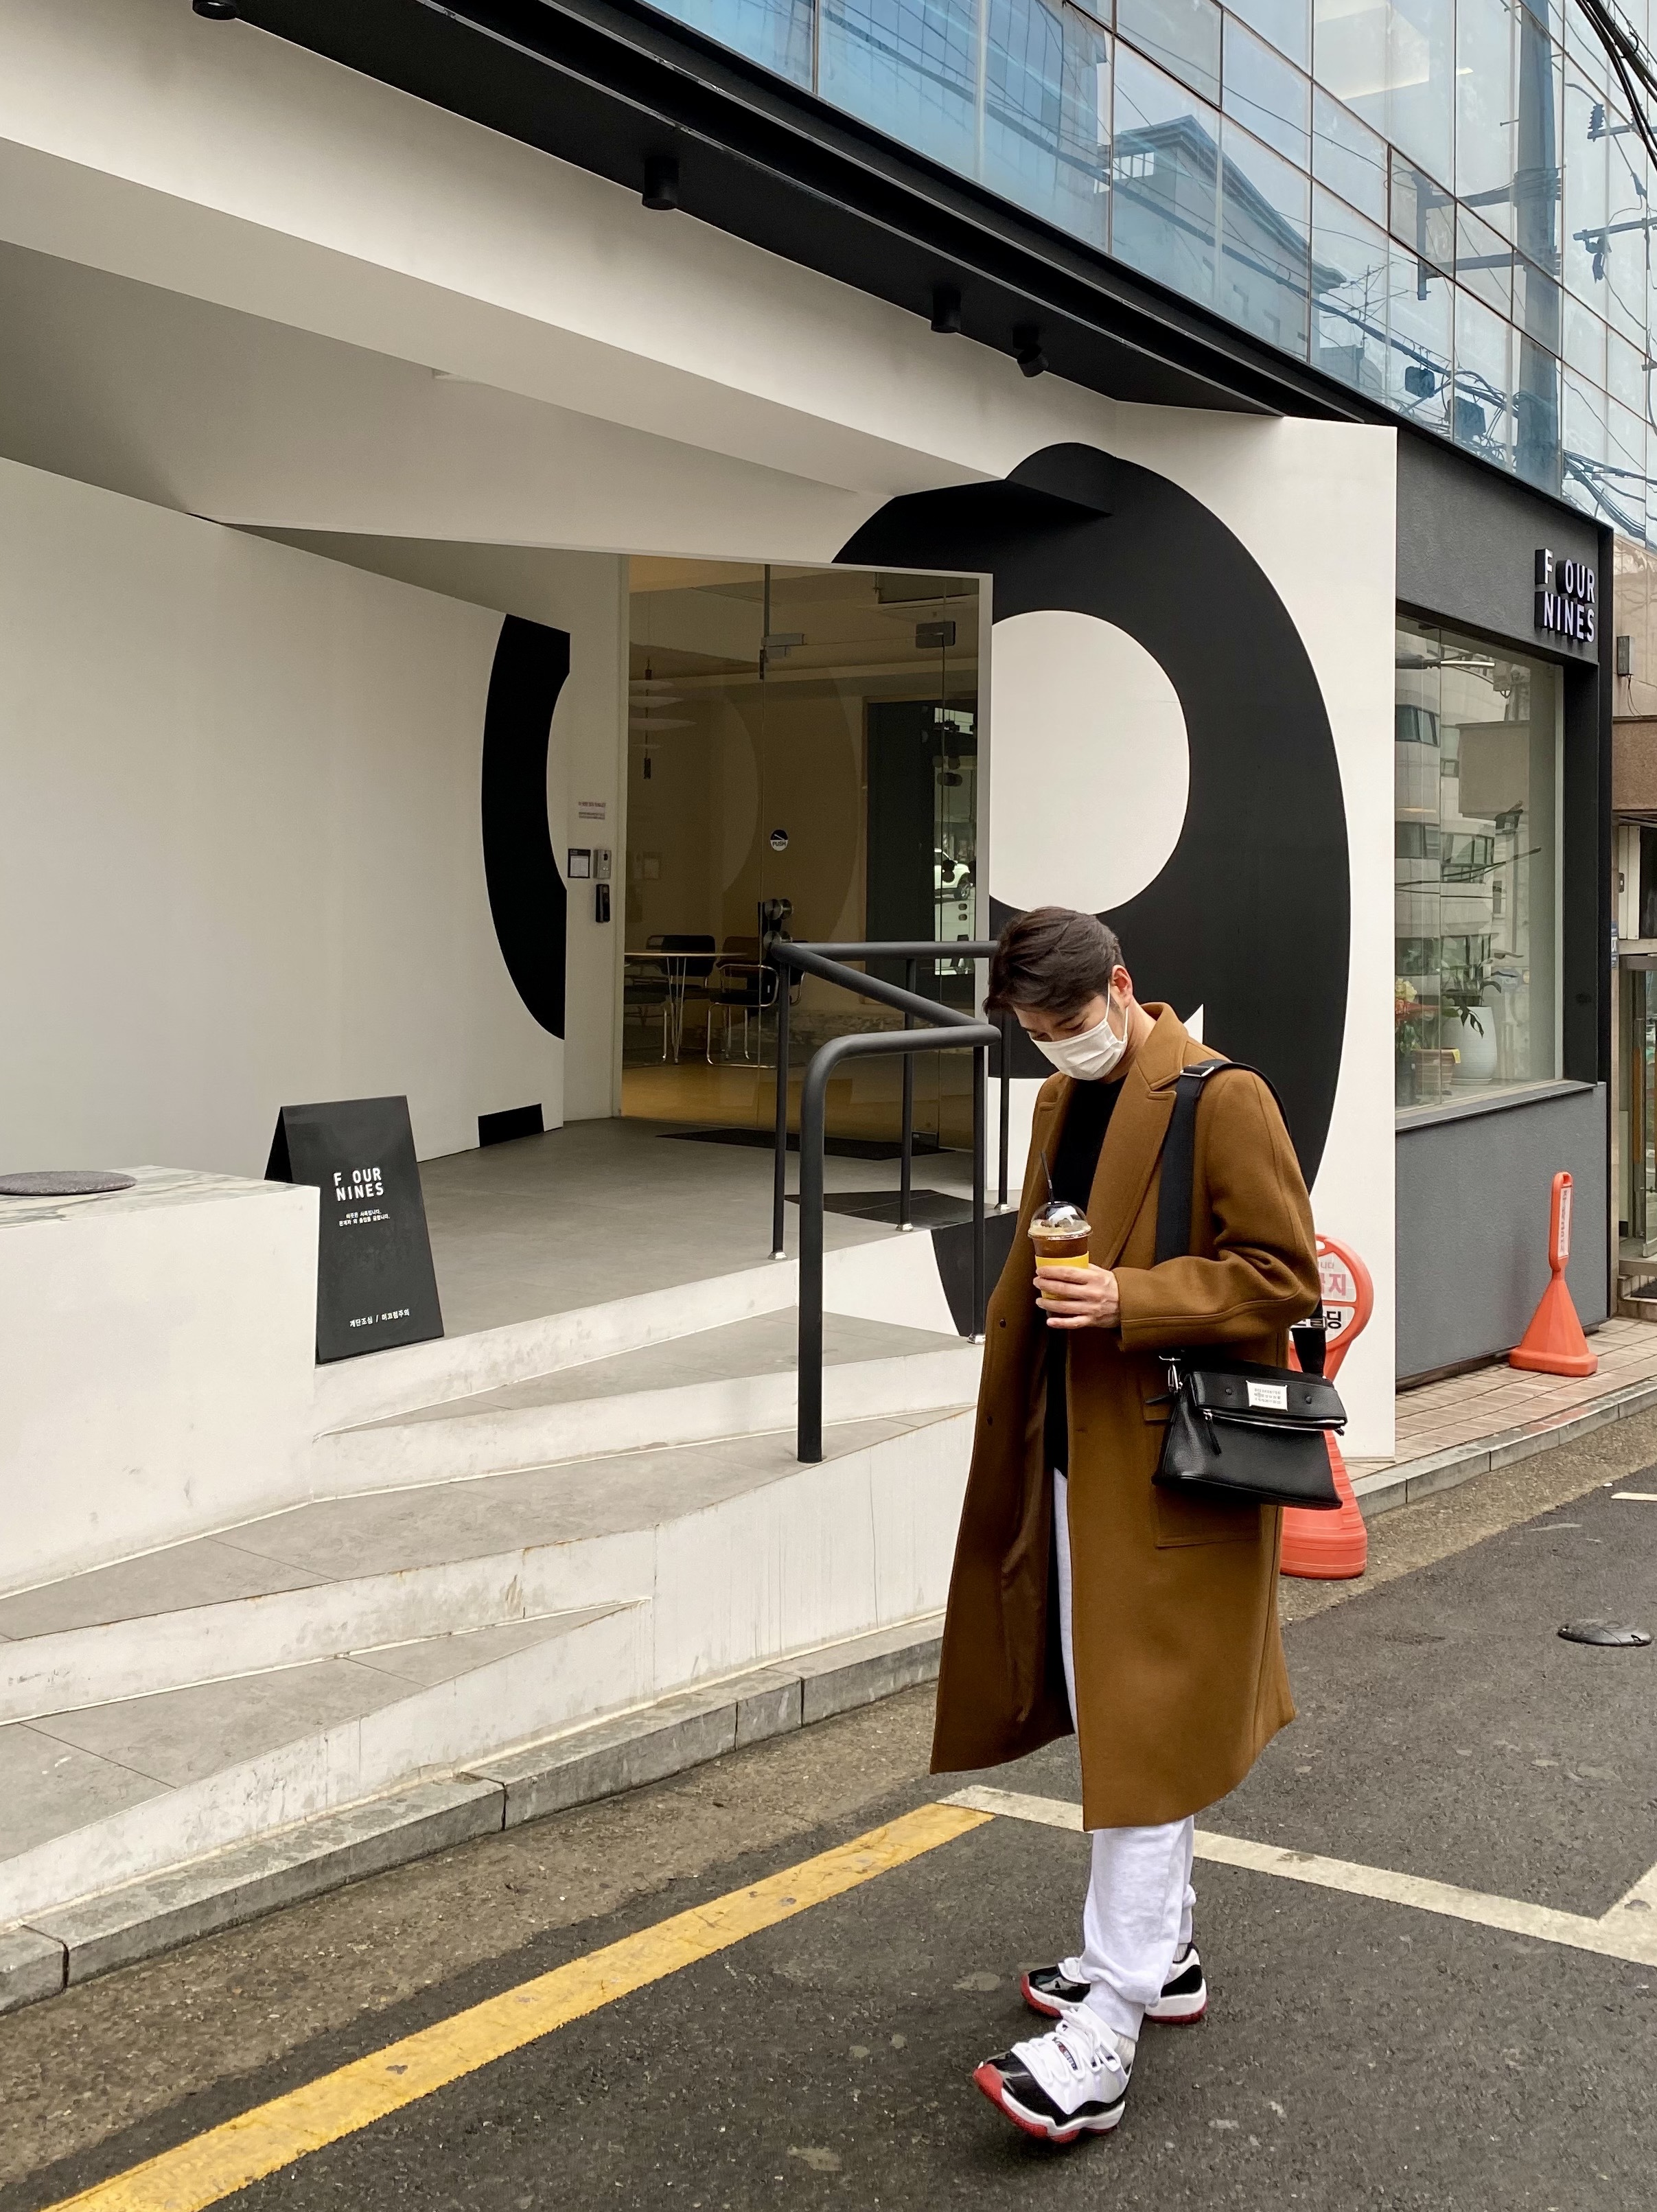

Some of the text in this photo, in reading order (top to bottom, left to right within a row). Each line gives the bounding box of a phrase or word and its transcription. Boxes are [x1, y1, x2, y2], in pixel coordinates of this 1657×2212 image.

[1544, 591, 1595, 643] NINES
[336, 1182, 384, 1201] NINES
[1317, 1260, 1334, 1270] 니다
[1319, 1272, 1346, 1296] 지
[349, 1316, 373, 1327] 계단조심
[381, 1309, 410, 1321] 미끄럼주의
